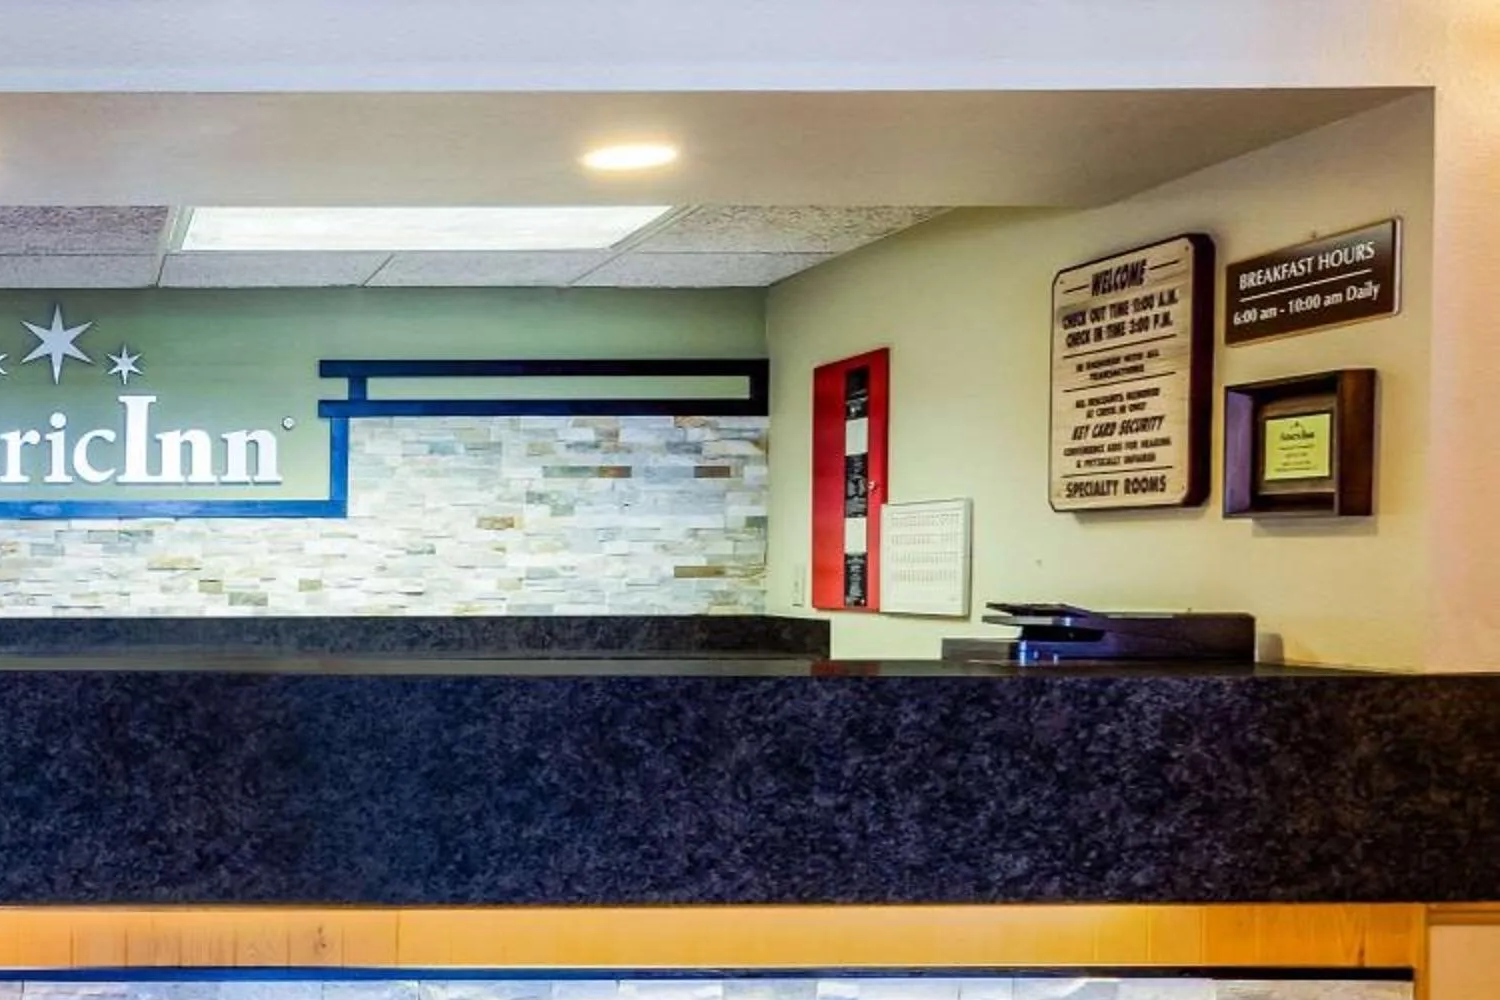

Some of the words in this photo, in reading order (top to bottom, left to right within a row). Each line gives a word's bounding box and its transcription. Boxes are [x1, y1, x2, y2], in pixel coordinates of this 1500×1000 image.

[1092, 259, 1147, 297] WELCOME
[1239, 256, 1314, 290] BREAKFAST
[1318, 242, 1375, 271] HOURS
[1062, 311, 1086, 330] CHECK
[1090, 306, 1106, 323] OUT
[1109, 300, 1129, 319] TIME
[1233, 308, 1257, 326] 6:00
[1259, 306, 1277, 320] am
[1288, 294, 1321, 315] 10:00
[1323, 293, 1343, 307] am
[1346, 280, 1380, 301] Daily
[1066, 329, 1090, 348] CHECK
[1093, 326, 1102, 342] IN
[1106, 321, 1126, 339] TIME
[1071, 425, 1090, 440] KEY
[1092, 422, 1117, 438] CARD
[1118, 415, 1166, 435] SECURITY
[1065, 479, 1119, 498] SPECIALTY
[1124, 475, 1166, 495] ROOMS
